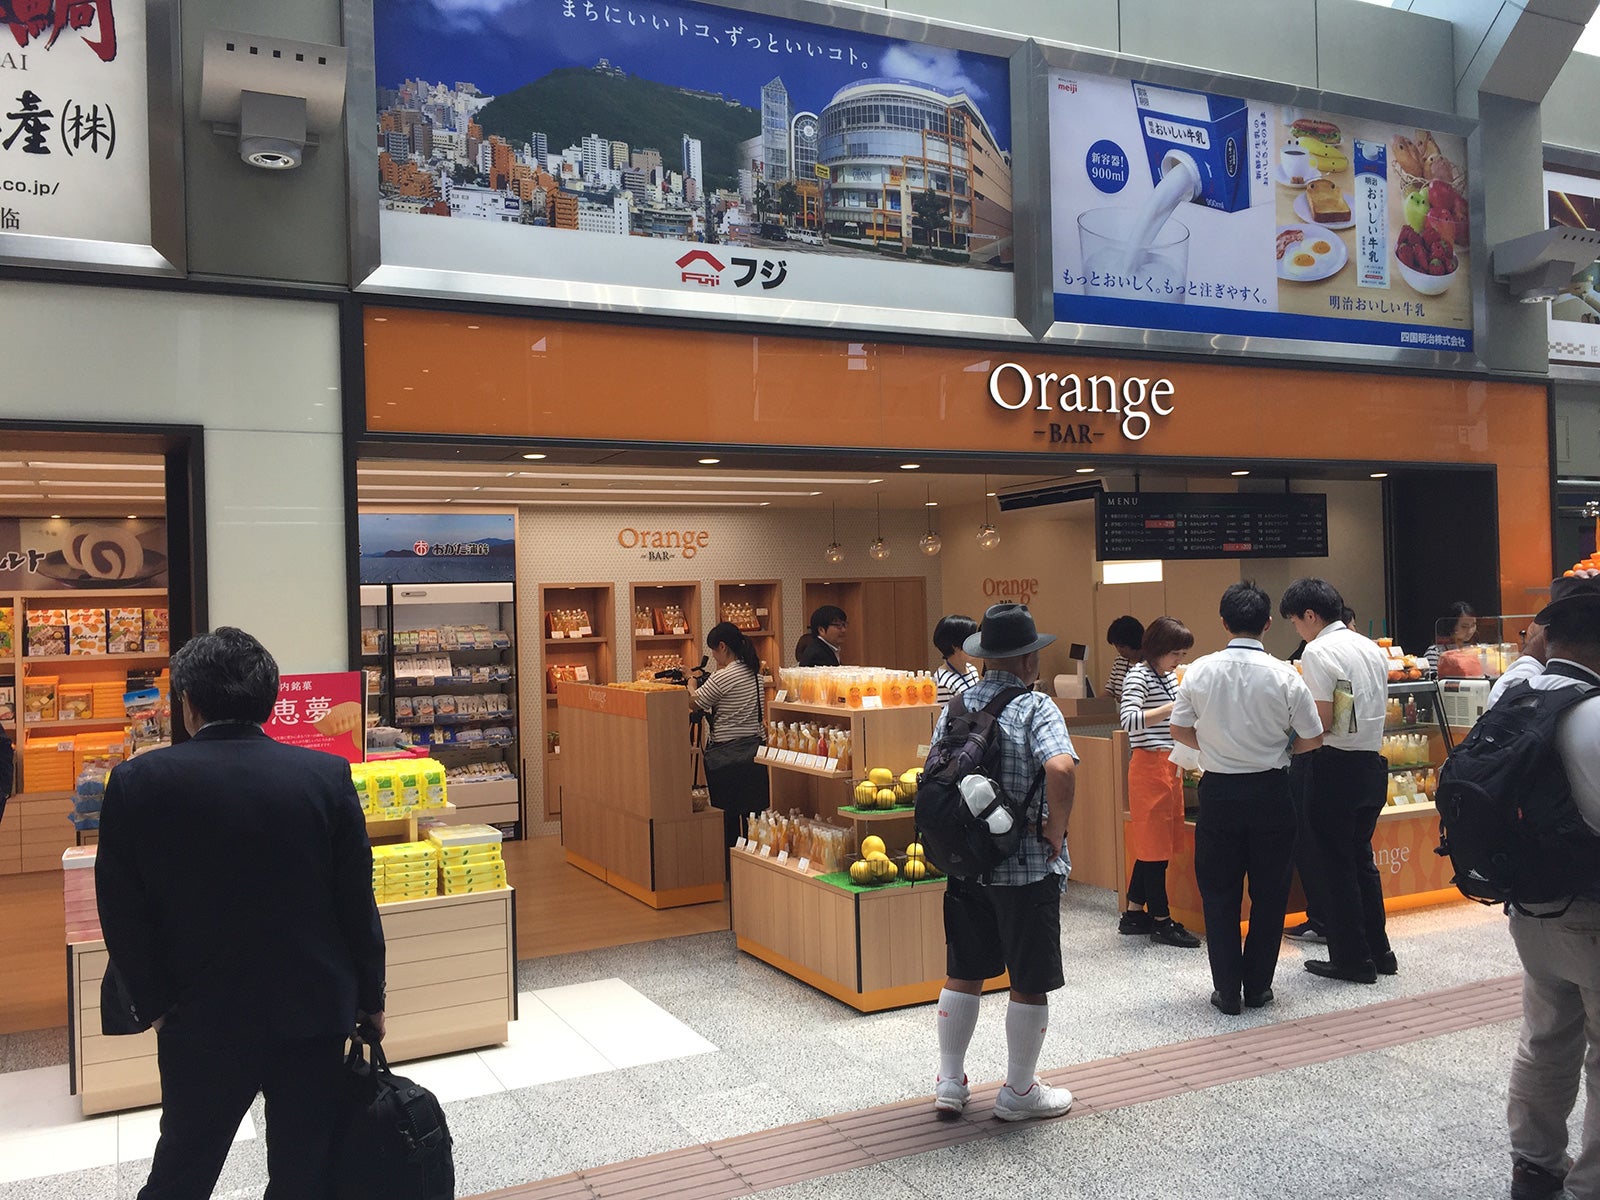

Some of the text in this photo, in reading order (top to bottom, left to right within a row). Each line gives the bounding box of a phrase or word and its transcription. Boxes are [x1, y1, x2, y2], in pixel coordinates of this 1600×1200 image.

[561, 0, 869, 69] まちにいいトコ、ずっといいコト。
[1057, 83, 1078, 94] meiji
[1091, 167, 1125, 182] 900ml
[1367, 187, 1379, 263] おいしい牛乳
[731, 257, 788, 290] フジ
[1062, 268, 1268, 305] もっとおいしく。もっと注ぎやすく。
[1329, 295, 1426, 317] 明治おいしい牛乳
[1400, 331, 1466, 348] 四国明治株式会社
[989, 362, 1175, 440] Orange
[1107, 497, 1138, 506] MENU
[617, 527, 709, 559] Orange
[982, 577, 1039, 605] Orange
